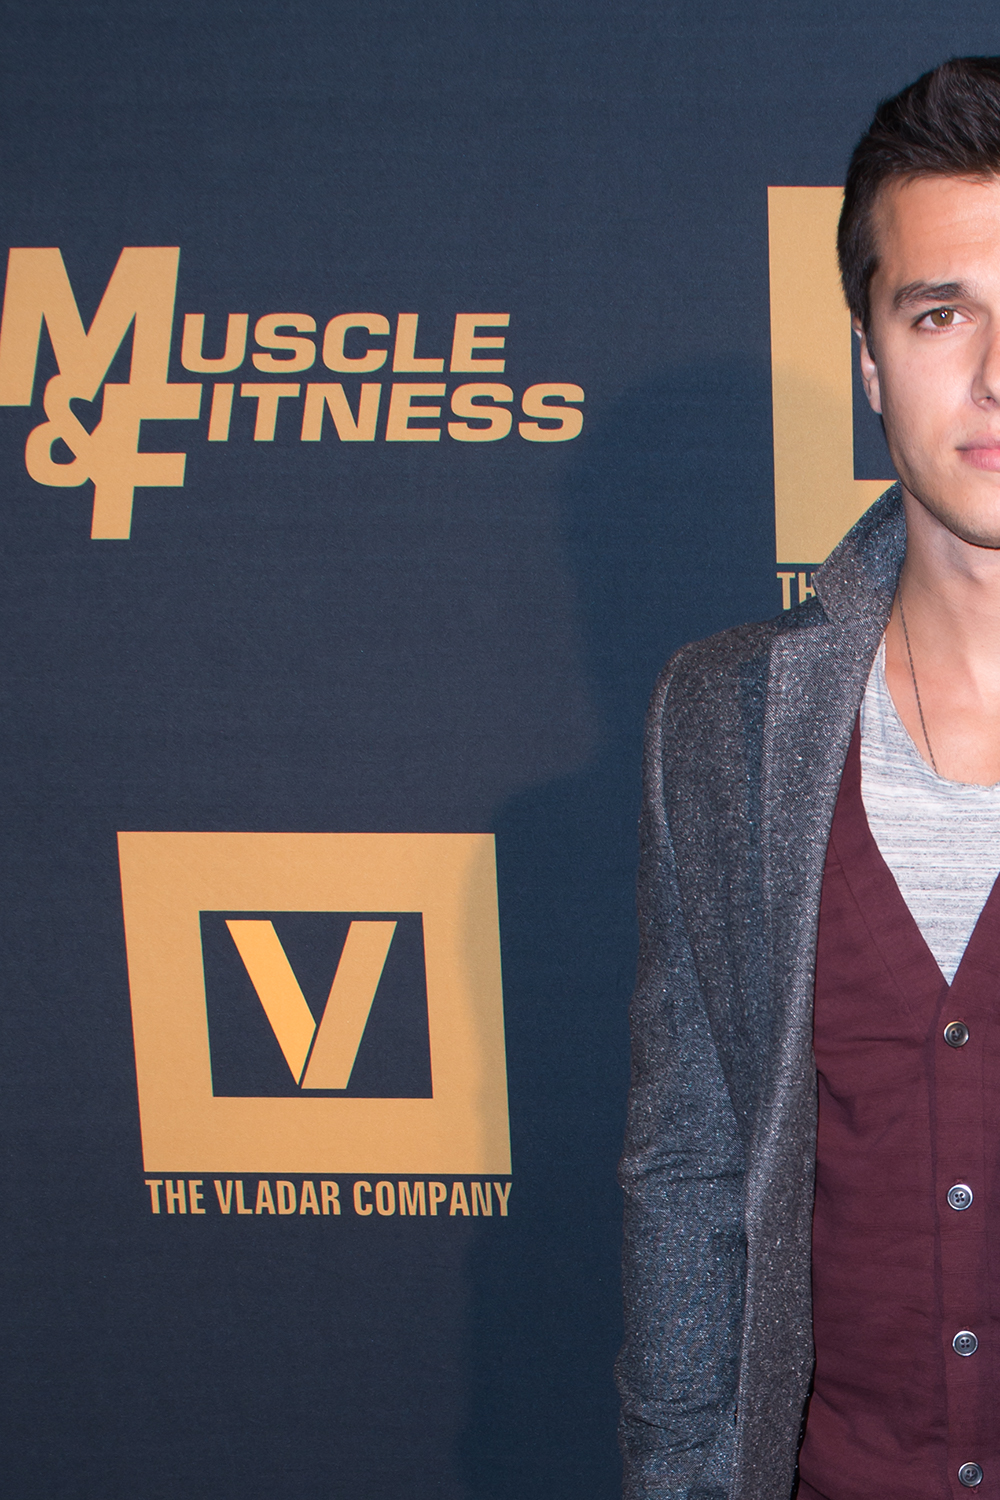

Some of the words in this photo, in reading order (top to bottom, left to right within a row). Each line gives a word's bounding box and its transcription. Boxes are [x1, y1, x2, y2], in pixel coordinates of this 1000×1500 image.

[0, 246, 510, 406] MUSCLE
[776, 571, 817, 610] TH
[225, 920, 397, 1089] V
[145, 1180, 206, 1214] THE
[217, 1180, 341, 1215] VLADAR
[353, 1181, 513, 1217] COMPANY
